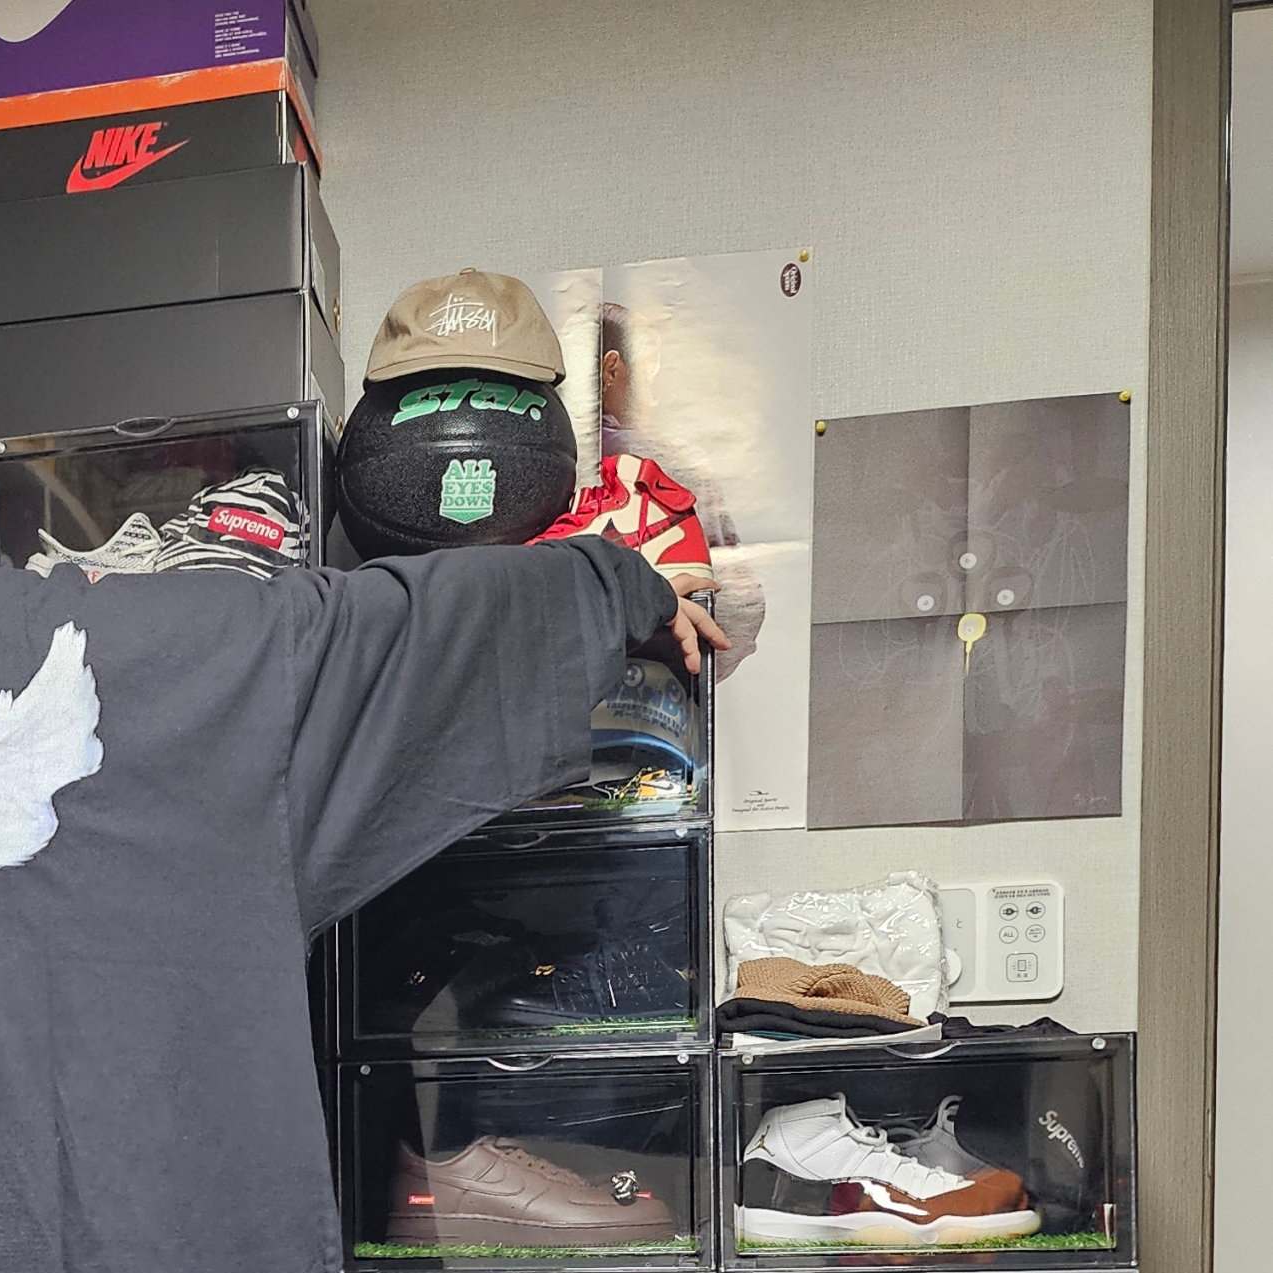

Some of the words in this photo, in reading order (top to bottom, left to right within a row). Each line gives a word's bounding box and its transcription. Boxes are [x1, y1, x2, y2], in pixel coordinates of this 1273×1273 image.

[83, 121, 162, 170] NIKE
[447, 459, 493, 480] ALL
[441, 496, 493, 508] DOWN
[442, 480, 494, 496] EYES
[212, 507, 282, 544] Supreme
[1036, 1109, 1085, 1170] Supreme
